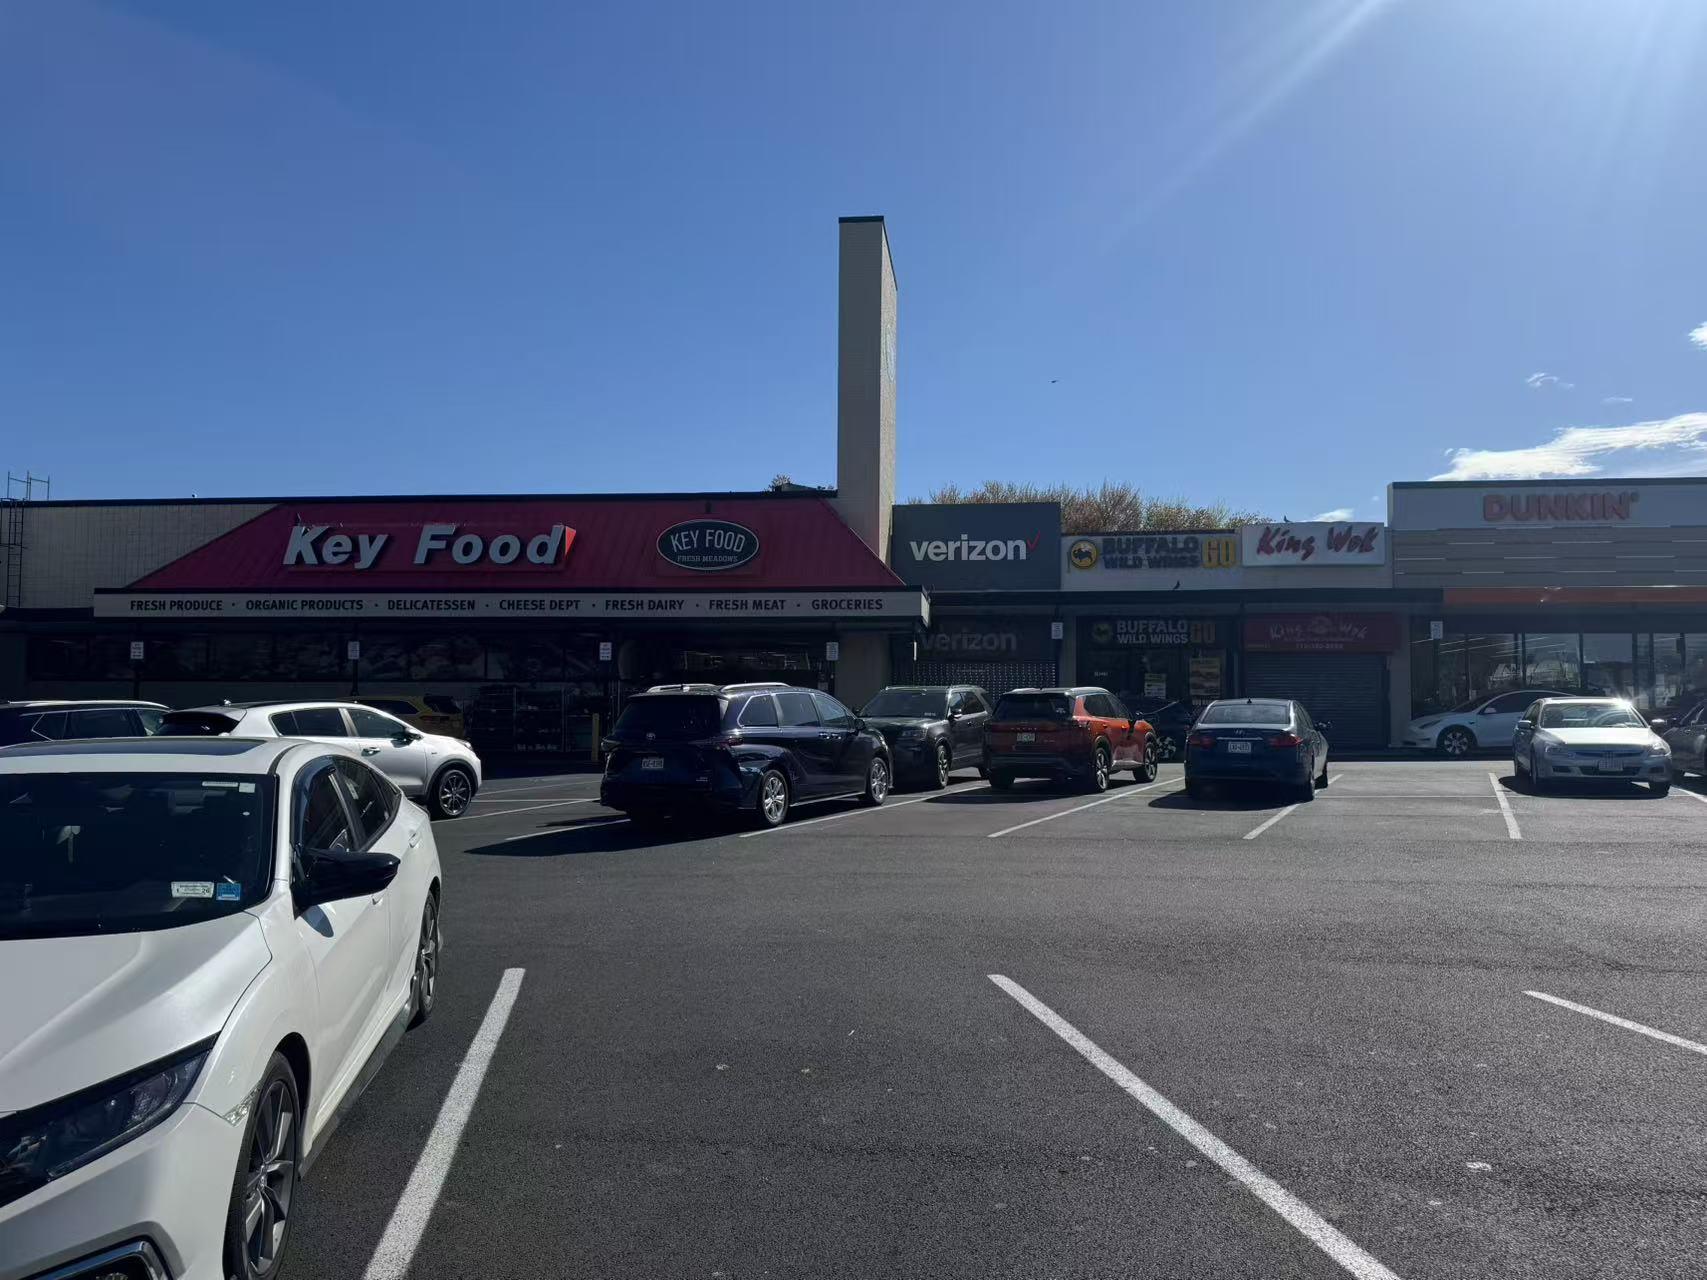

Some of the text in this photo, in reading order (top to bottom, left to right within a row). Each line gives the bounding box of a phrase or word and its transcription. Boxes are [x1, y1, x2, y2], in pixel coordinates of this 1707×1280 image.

[283, 523, 565, 570] Key Food
[670, 529, 746, 553] KEY FOOD
[1101, 537, 1199, 553] BUFFALO
[1257, 525, 1380, 560] King Wok
[909, 534, 1027, 561] verizon
[1202, 537, 1236, 569] GO
[677, 555, 738, 563] FRESH MEADOWS
[1102, 554, 1199, 569] WILD WINGS
[130, 600, 223, 610] FRESH PRODUCE
[246, 600, 363, 610] ORGANIC PRODUCTS
[388, 600, 475, 610] DELICATESSEN
[500, 600, 579, 610] CHEESE DEPT
[605, 600, 685, 611] FRESH DAIRY
[709, 600, 786, 611] FRESH MEAT
[811, 600, 883, 611] GROCERIES
[1117, 620, 1188, 632] BUFFALO
[1117, 633, 1188, 644] WILD WINGS
